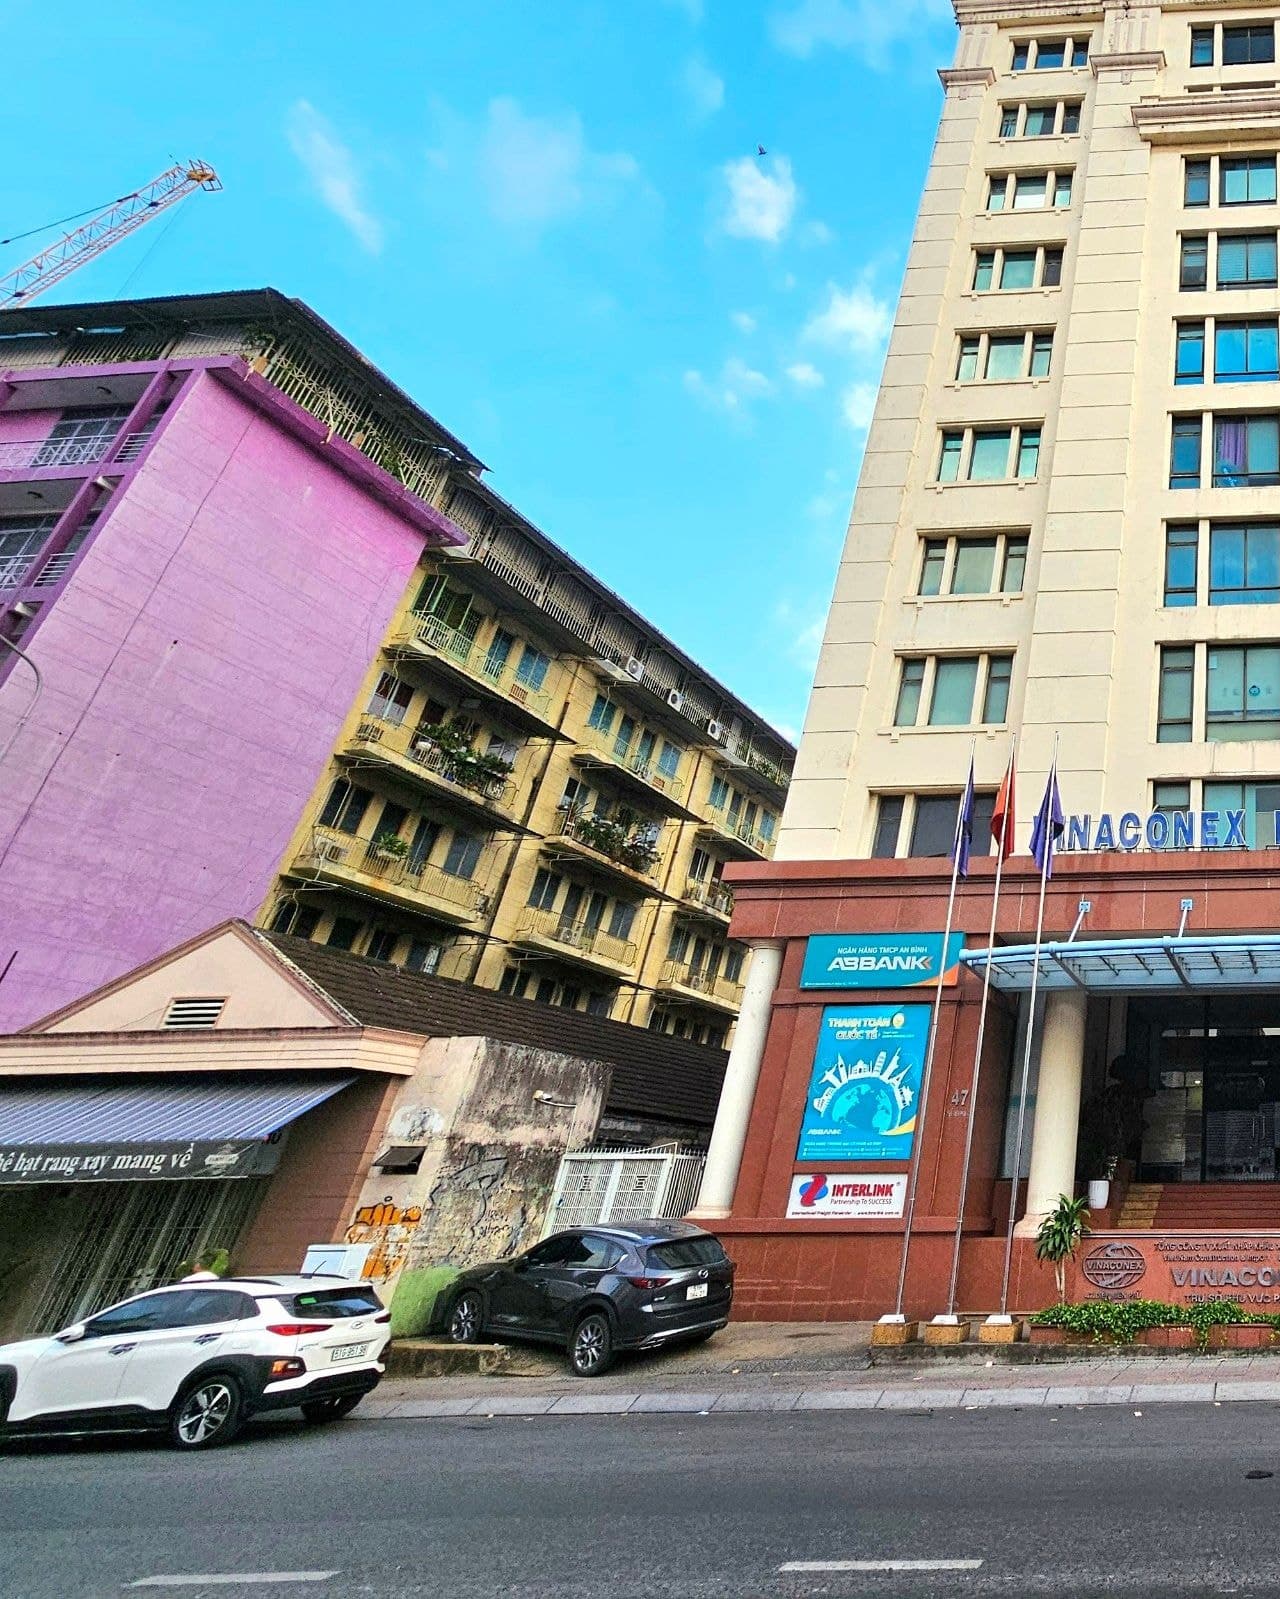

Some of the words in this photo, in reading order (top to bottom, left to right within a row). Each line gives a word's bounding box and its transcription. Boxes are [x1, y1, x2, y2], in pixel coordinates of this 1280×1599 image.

[1033, 808, 1247, 851] INACONEX
[837, 946, 857, 954] NGÂN
[858, 946, 878, 954] HÀNG
[911, 945, 928, 953] BÌNH
[827, 955, 931, 971] ABBANK
[951, 1089, 968, 1105] 47
[12, 1152, 43, 1177] hạt
[41, 1156, 80, 1176] rang
[79, 1155, 111, 1176] xay
[111, 1154, 167, 1174] mang
[170, 1142, 195, 1169] về
[831, 1183, 894, 1197] INTERLINK
[1086, 1261, 1143, 1271] VINACONEX
